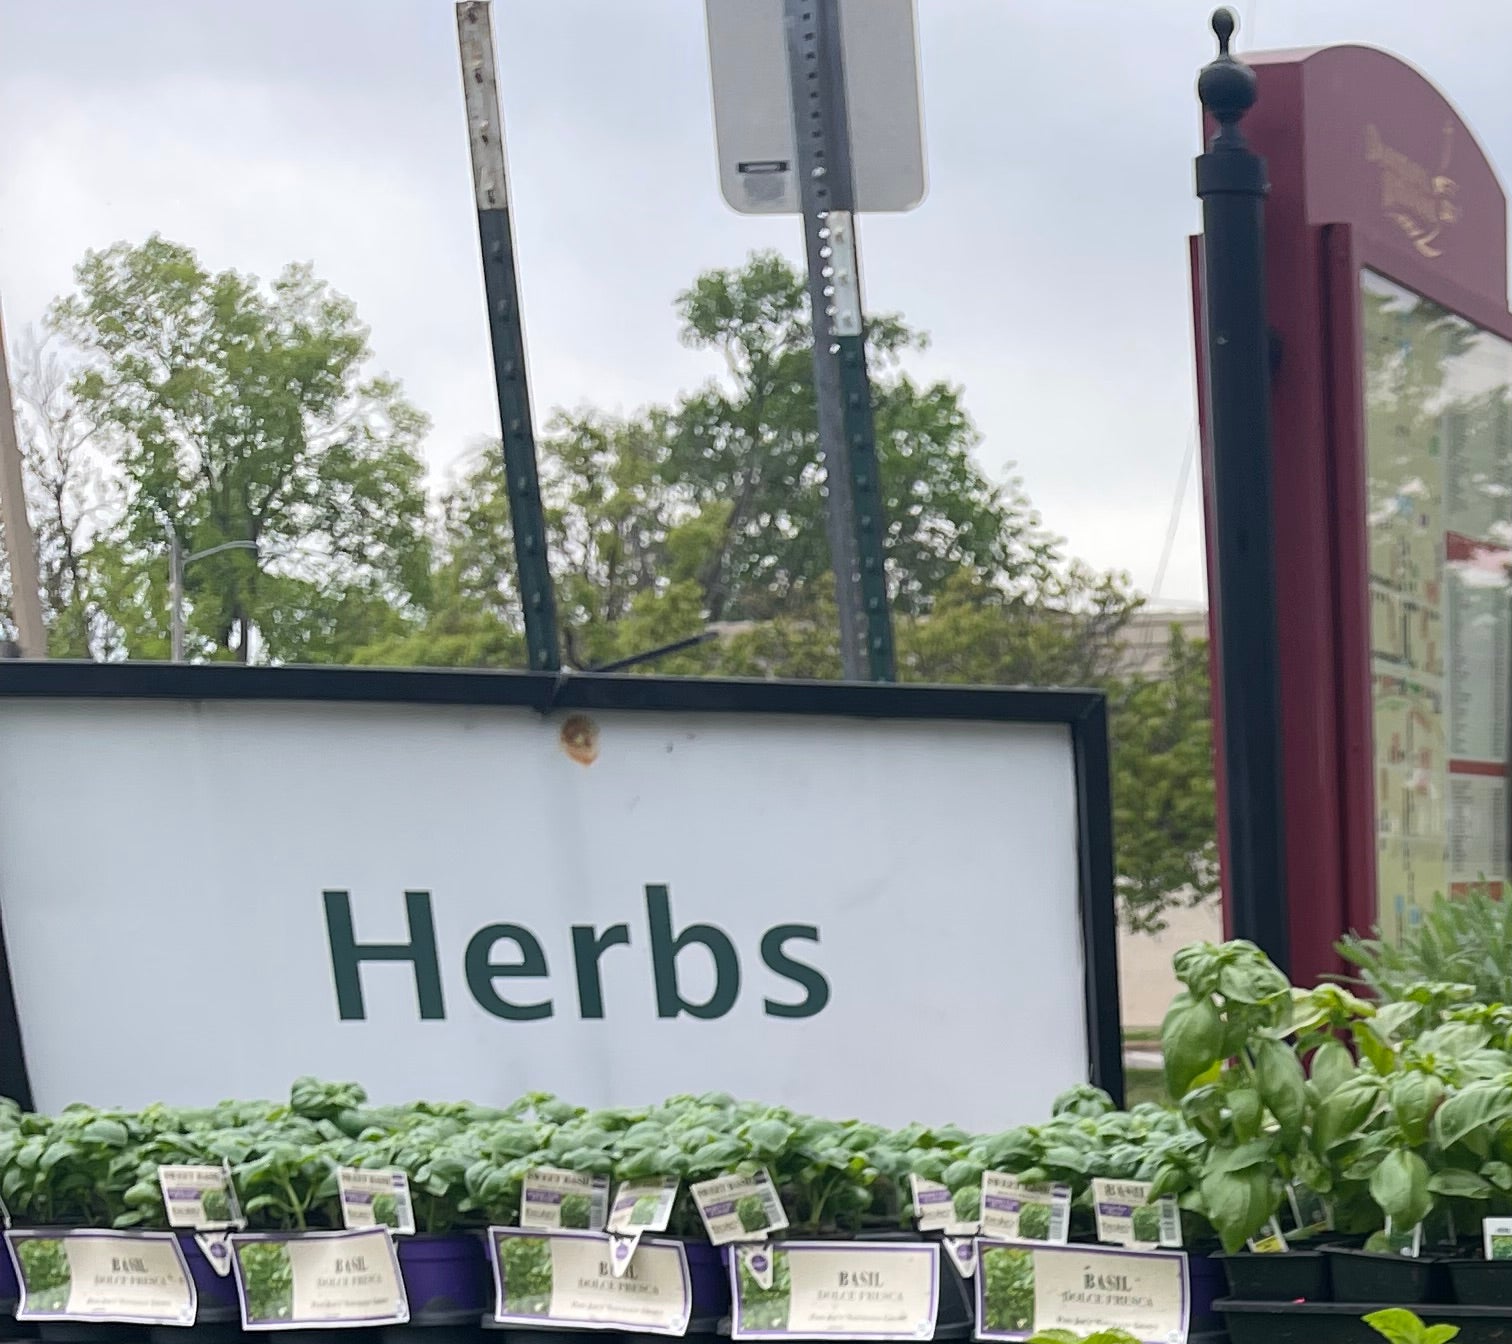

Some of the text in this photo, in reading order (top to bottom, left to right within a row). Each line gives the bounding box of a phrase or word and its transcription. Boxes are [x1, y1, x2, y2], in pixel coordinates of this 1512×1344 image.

[322, 885, 831, 1022] Herbs
[838, 1271, 884, 1288] BASIL
[1084, 1273, 1132, 1293] BASIL
